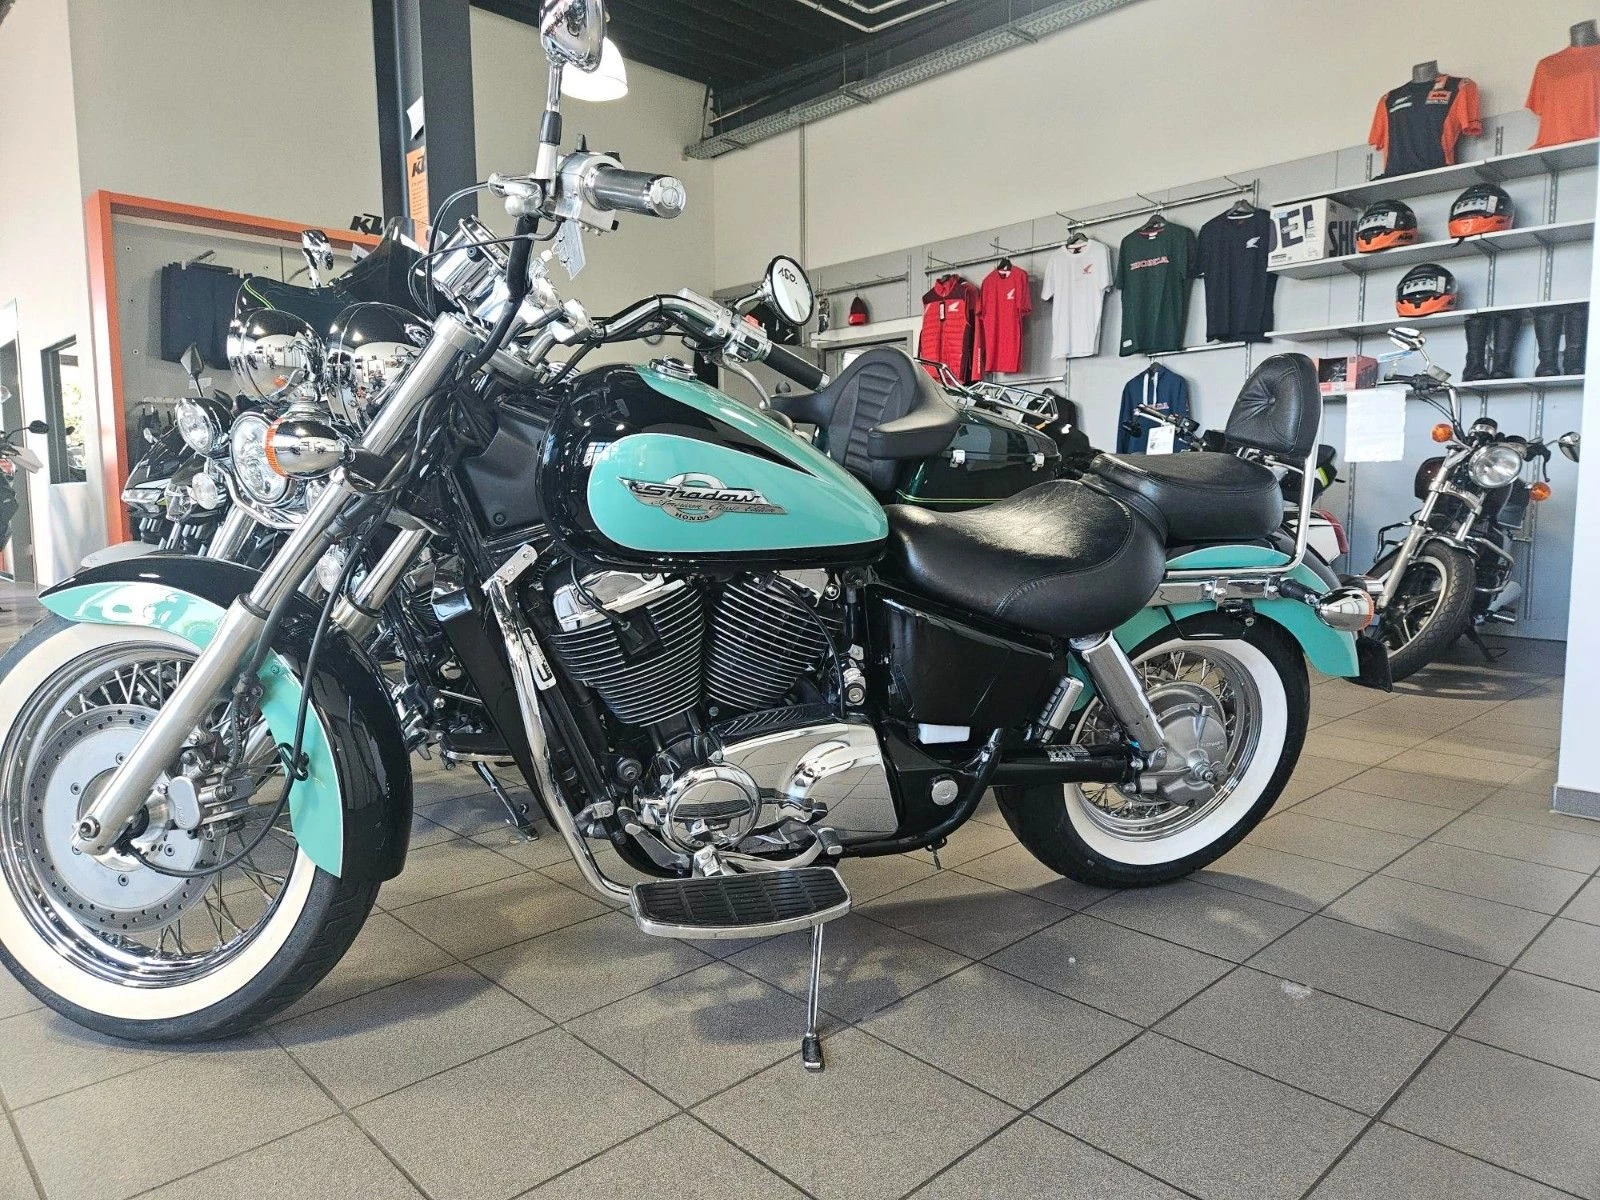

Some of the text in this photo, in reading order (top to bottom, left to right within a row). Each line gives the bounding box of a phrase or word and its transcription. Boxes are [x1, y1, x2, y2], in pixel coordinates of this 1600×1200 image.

[412, 155, 425, 177] KT
[350, 213, 382, 235] KT
[632, 484, 761, 503] Shadow
[674, 512, 710, 521] HONDA
